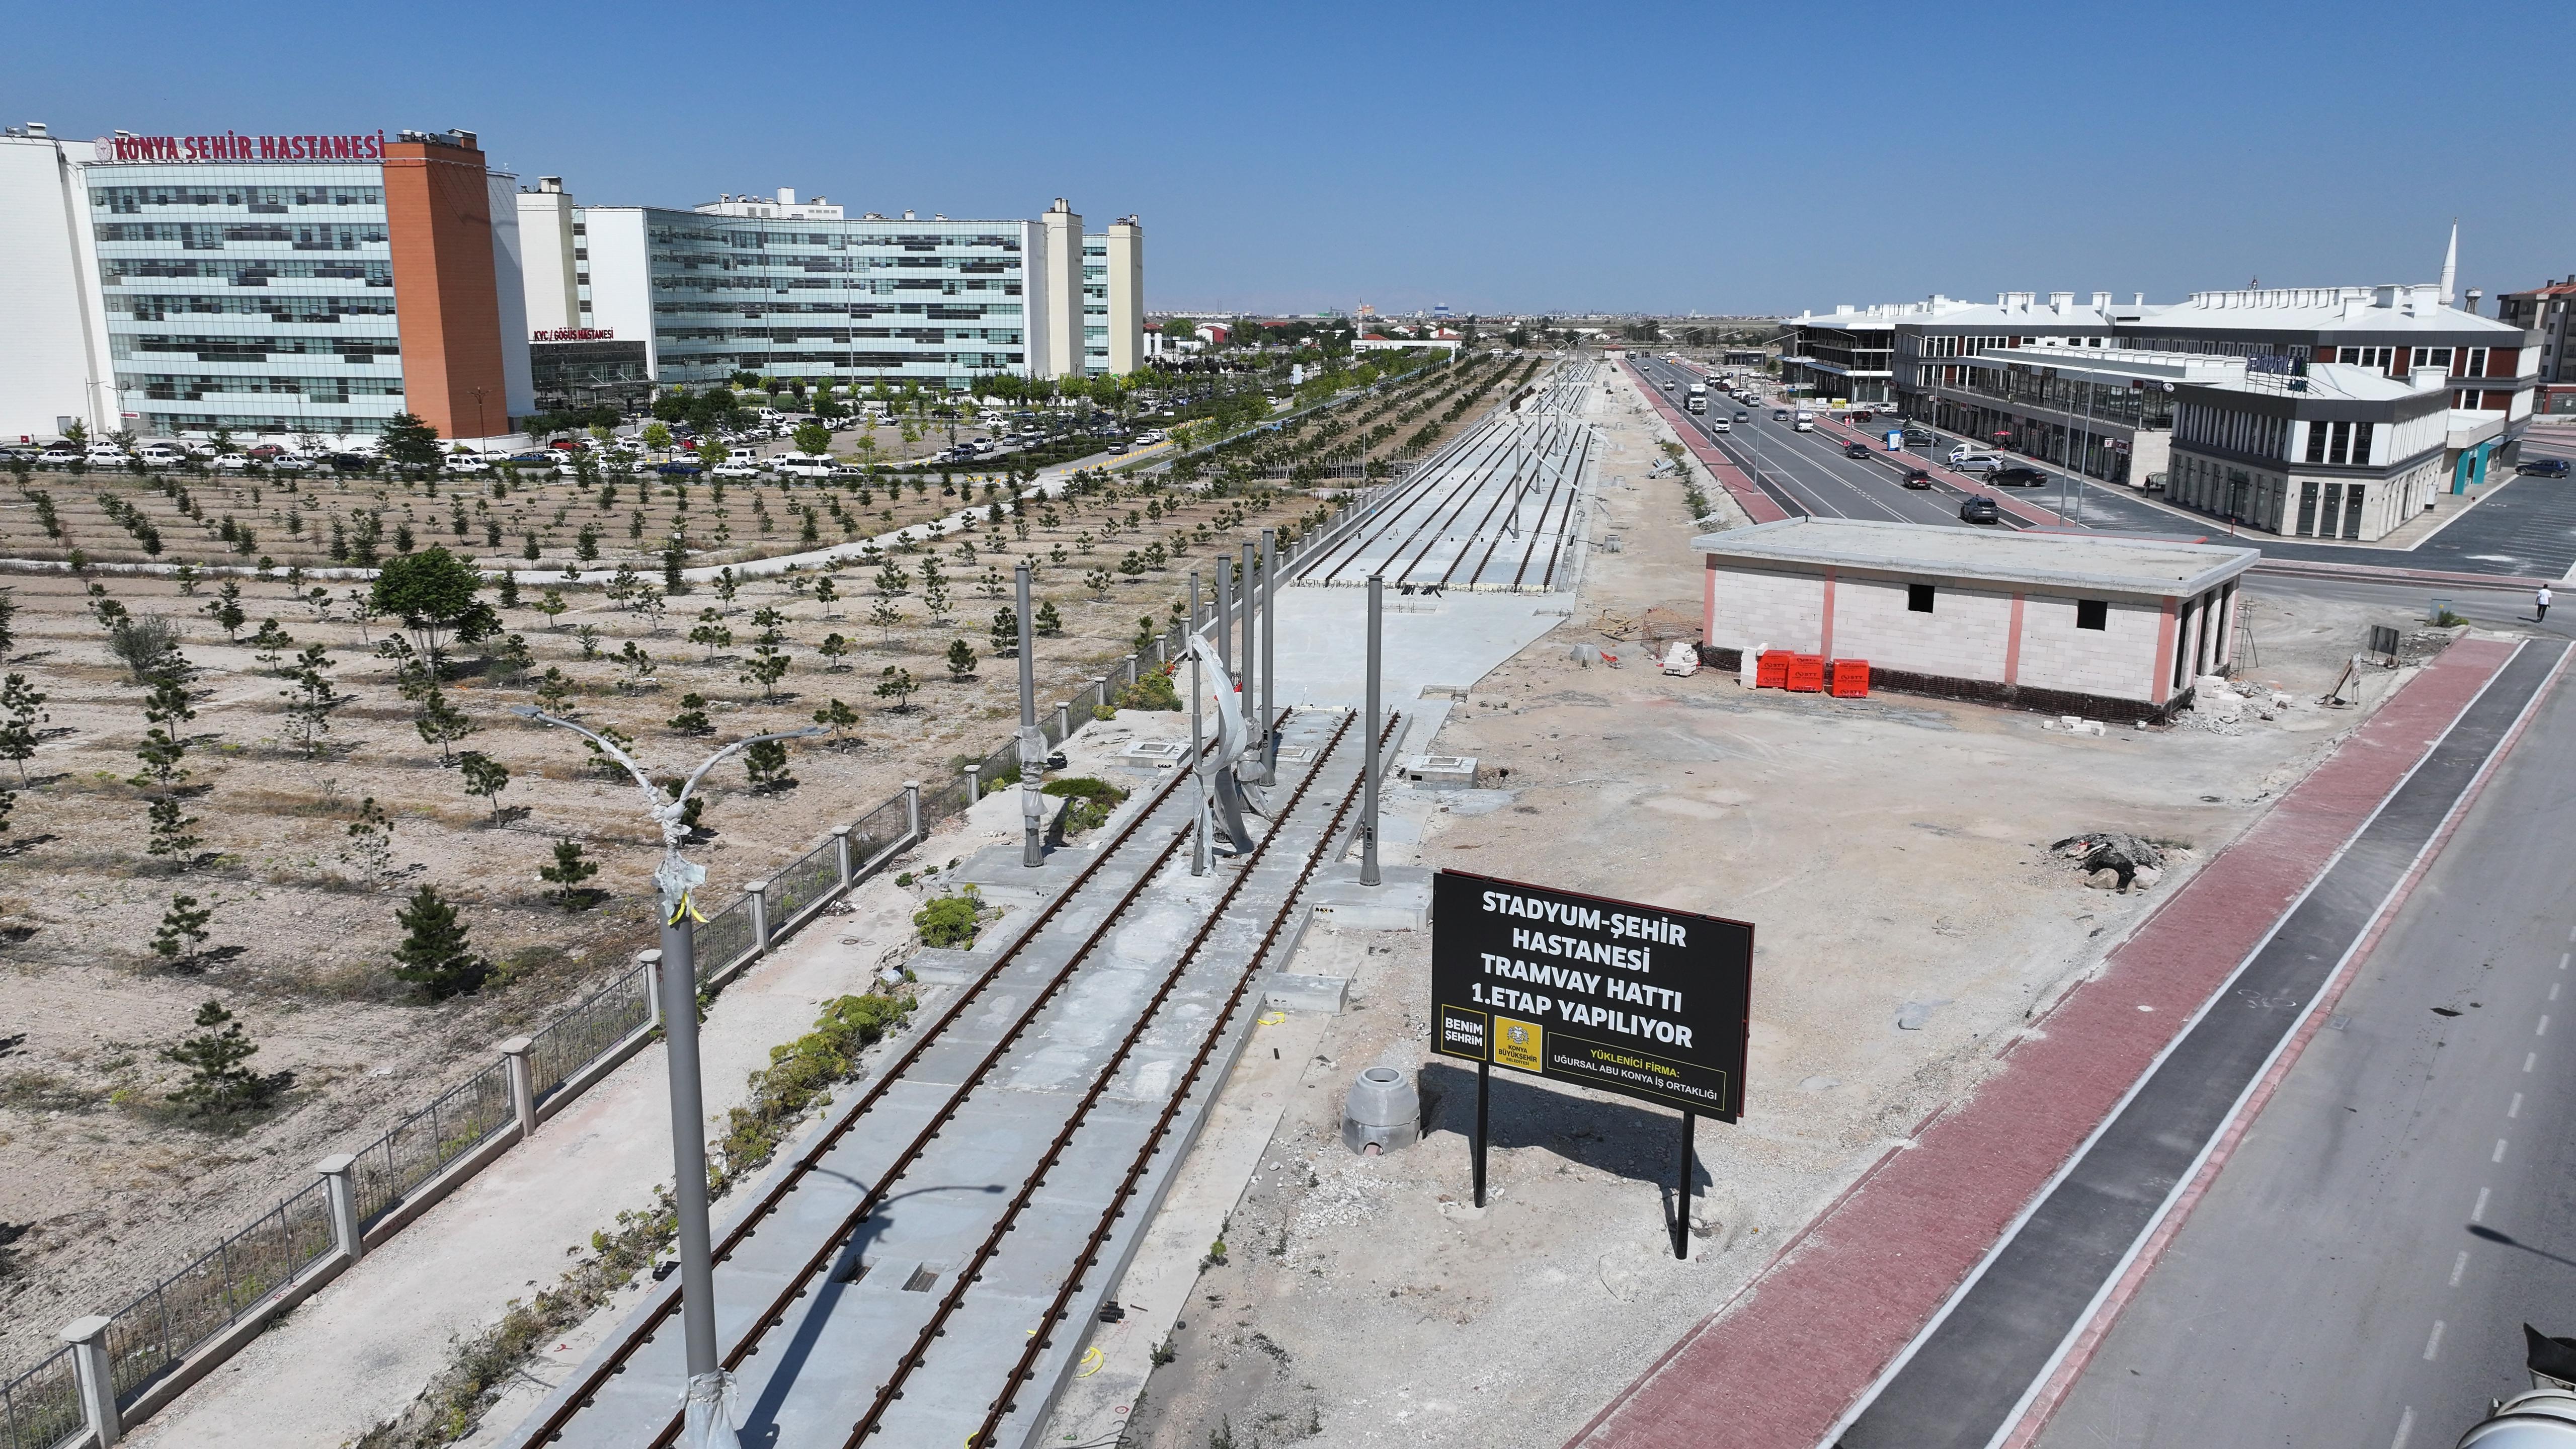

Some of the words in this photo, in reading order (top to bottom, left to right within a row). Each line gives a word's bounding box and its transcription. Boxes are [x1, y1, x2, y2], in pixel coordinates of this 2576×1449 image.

[114, 136, 178, 159] KONYA
[259, 129, 385, 158] HASTANESİ
[578, 327, 614, 339] HASTANESİ
[1482, 891, 1687, 948] STADYUM-ŞEHİR
[1512, 927, 1651, 974] HASTANESİ
[1481, 952, 1601, 995] TRAMVAY
[1607, 977, 1682, 1013] HATTI
[1472, 982, 1552, 1016] 1.ETAP
[1557, 999, 1693, 1049] YAPILIYOR
[1498, 1048, 1538, 1063] BÜYÜKŞEHİR
[1506, 1057, 1530, 1066] BELEDİYESİ
[1508, 1044, 1527, 1054] KONYA
[1590, 1049, 1643, 1069] YÜKLENİCİ
[1645, 1061, 1680, 1078] FİRMA:
[1554, 1054, 1598, 1071] UĞURSAL
[1599, 1065, 1619, 1076] ABU
[1621, 1069, 1653, 1084] KONYA
[1655, 1075, 1664, 1088] İŞ
[1666, 1081, 1718, 1100] ORTAKLIĞI
